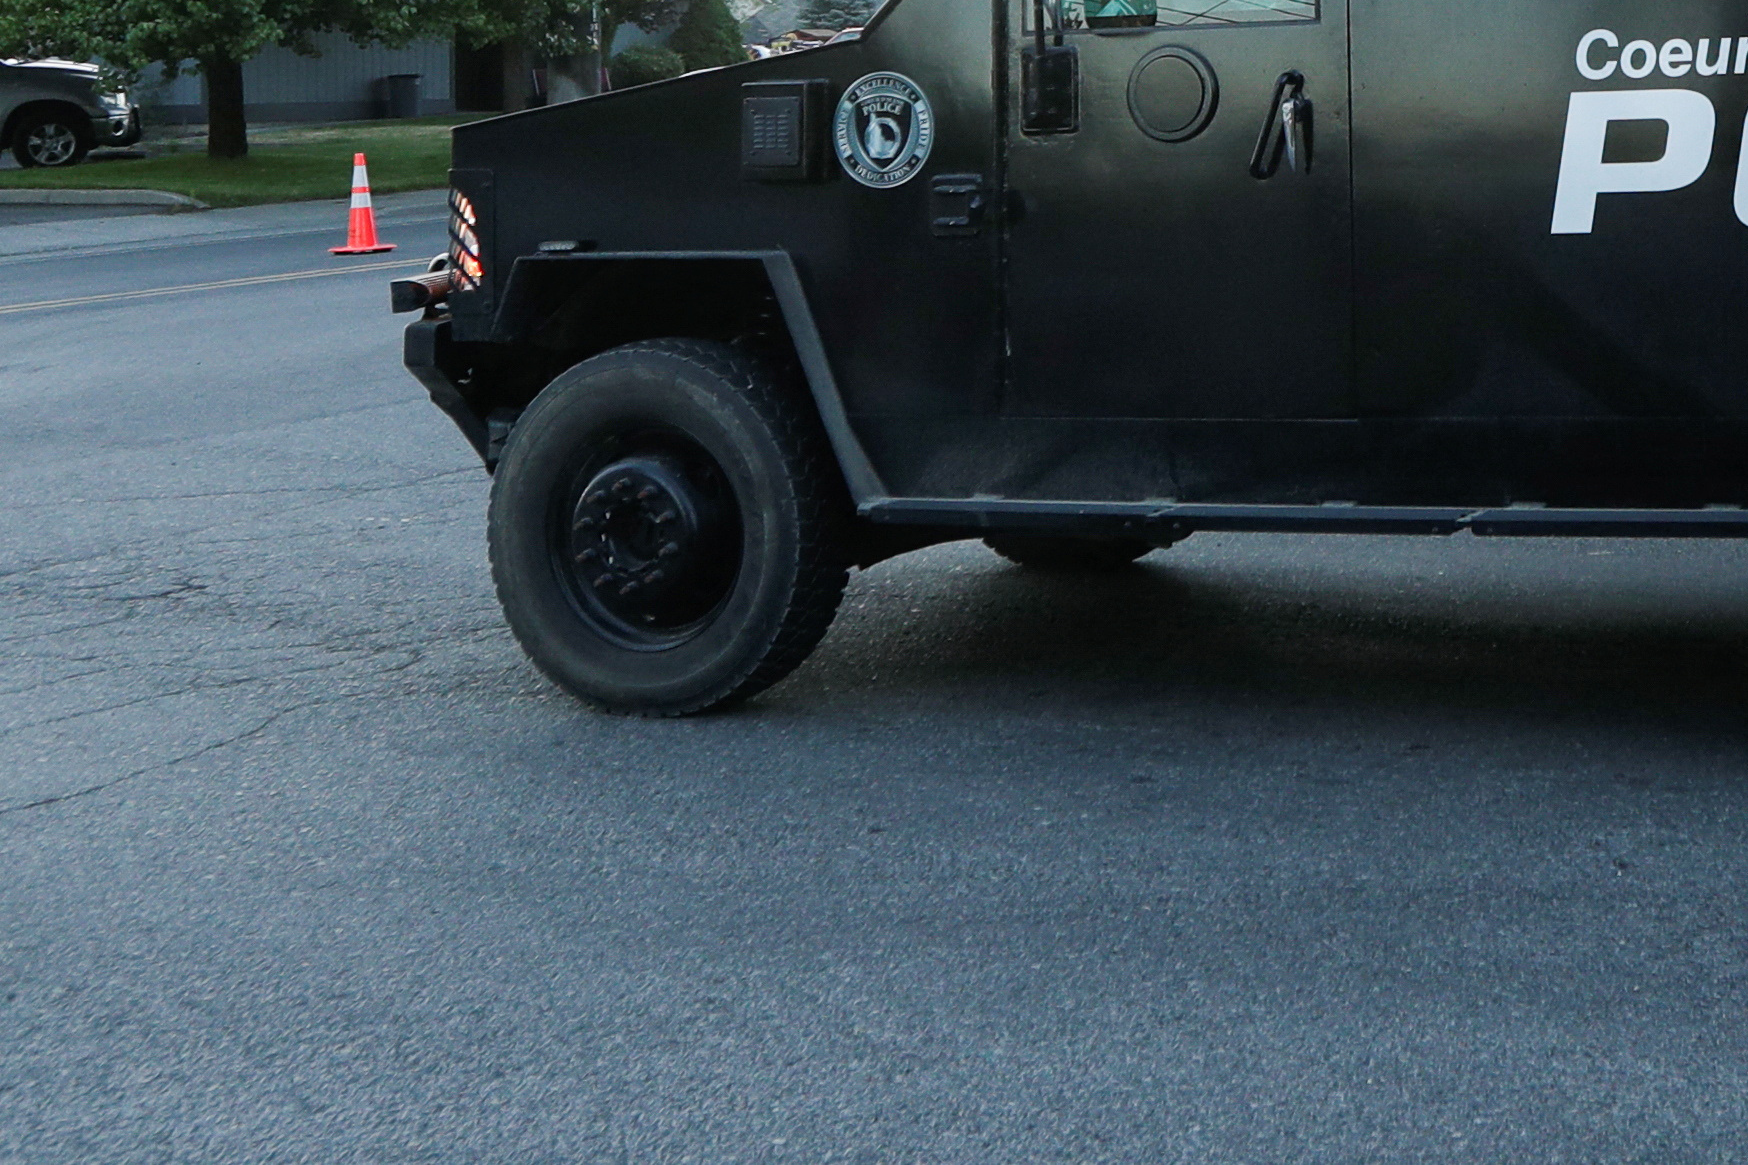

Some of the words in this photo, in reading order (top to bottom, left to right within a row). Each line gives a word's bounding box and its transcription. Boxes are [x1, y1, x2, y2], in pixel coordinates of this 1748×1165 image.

[855, 78, 911, 98] EXCELLENCE
[861, 102, 902, 116] POLICE
[836, 110, 850, 154] SERVICE
[917, 109, 930, 149] PRIDE
[854, 164, 913, 183] DEDICATION
